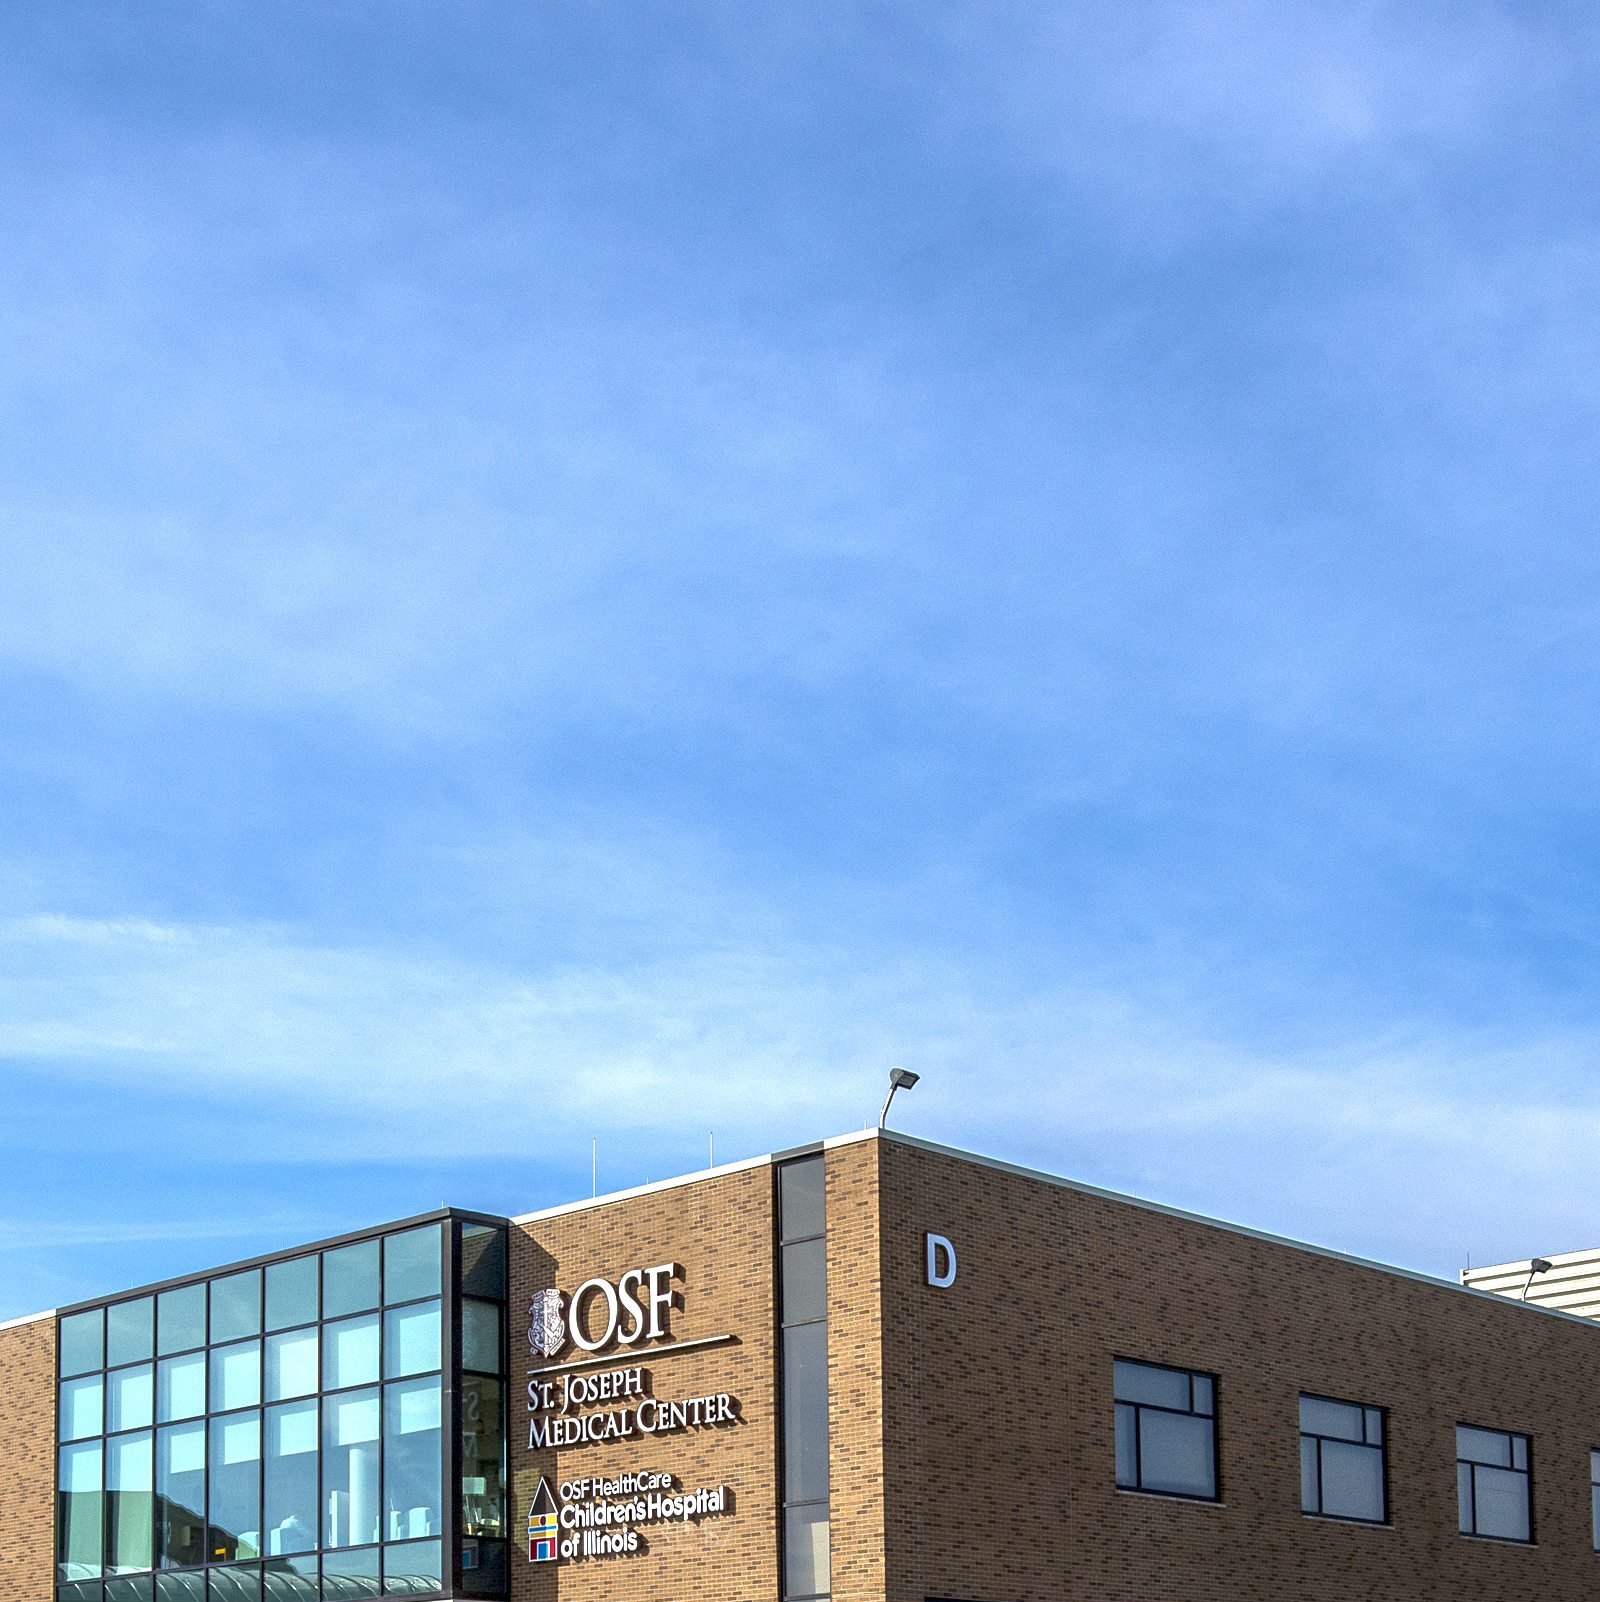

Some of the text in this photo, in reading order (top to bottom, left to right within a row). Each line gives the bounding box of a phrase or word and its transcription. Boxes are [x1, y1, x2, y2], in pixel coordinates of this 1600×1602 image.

[927, 1232, 957, 1288] D
[569, 1262, 675, 1350] OSF
[527, 1367, 643, 1414] ST. JOSEPH
[528, 1393, 735, 1449] MEDICAL CENTER
[560, 1471, 671, 1500] OSF HealthCare
[560, 1485, 725, 1528] Children's Hospital
[560, 1527, 638, 1557] of Illinois
